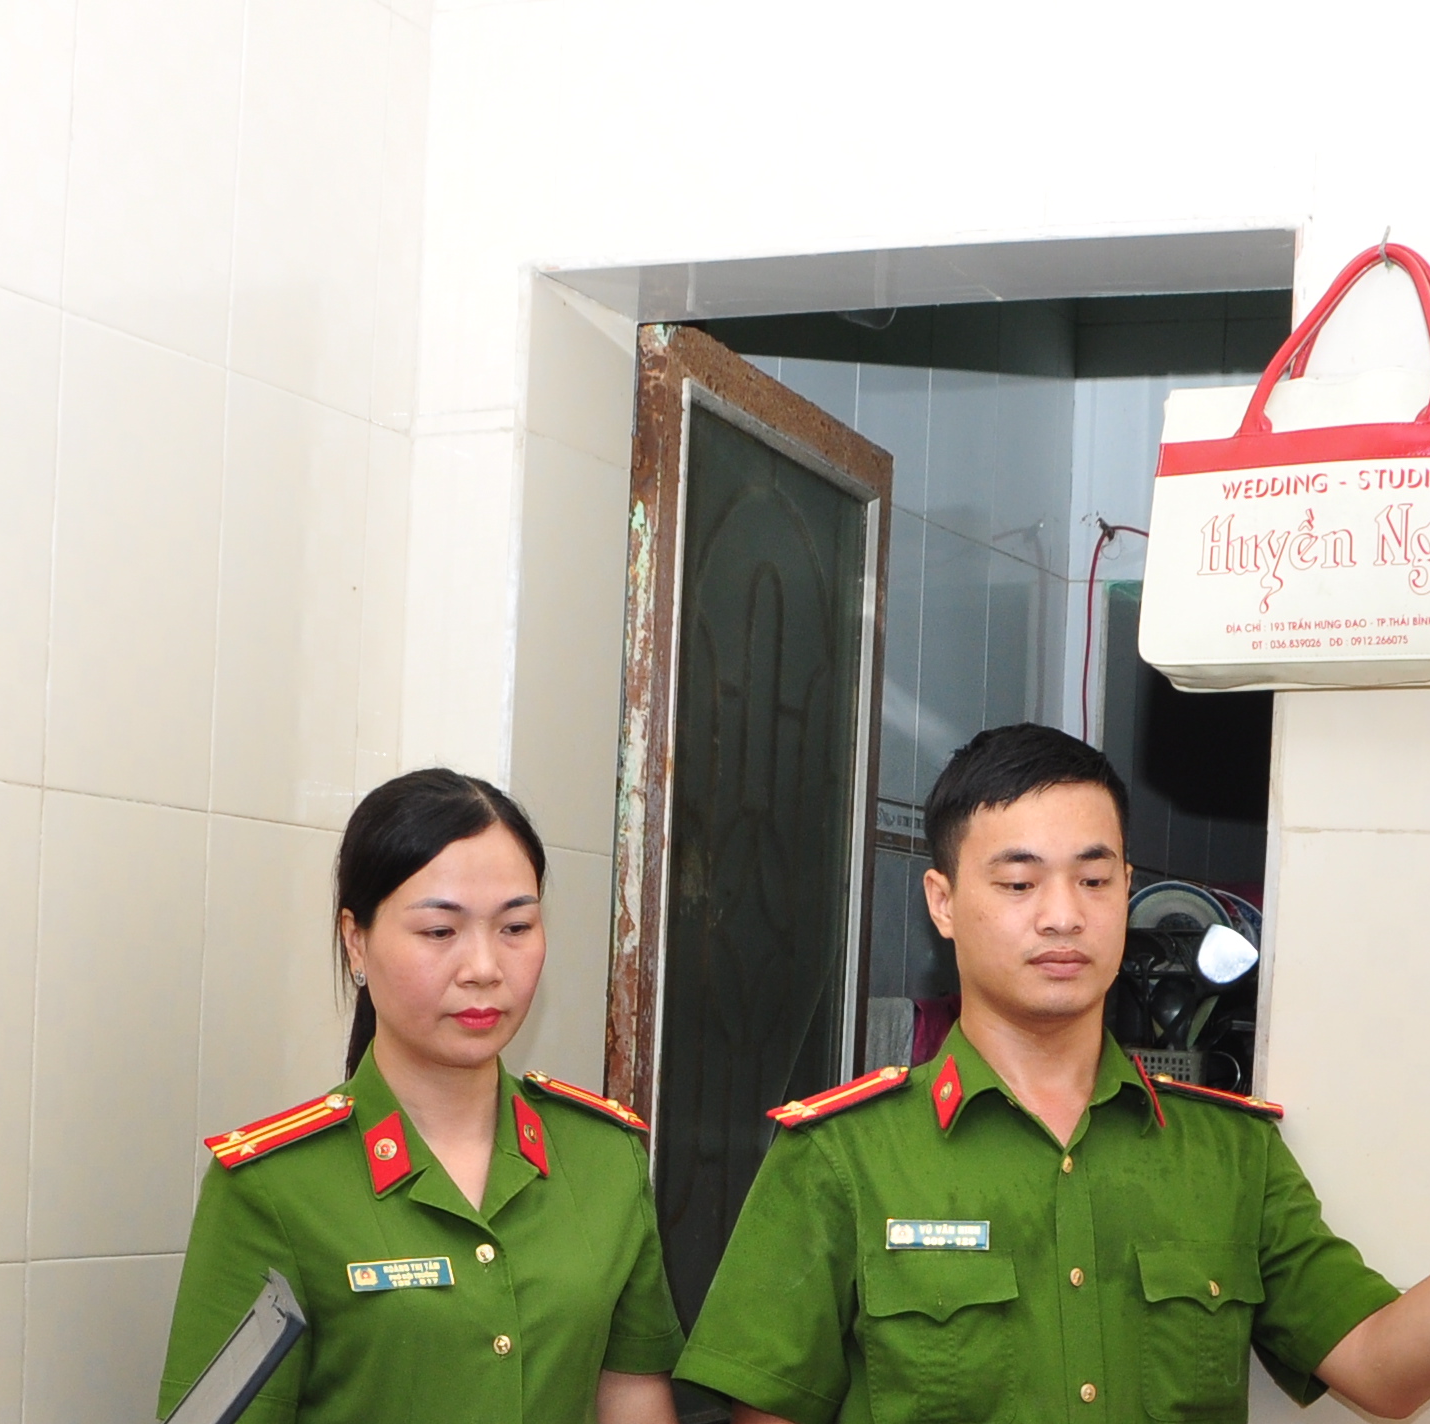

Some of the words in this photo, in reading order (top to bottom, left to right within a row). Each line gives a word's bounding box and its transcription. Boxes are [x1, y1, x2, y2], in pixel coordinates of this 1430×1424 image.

[1222, 473, 1328, 500] WEDDING
[1197, 508, 1357, 614] Huyền
[1270, 621, 1285, 632] 193
